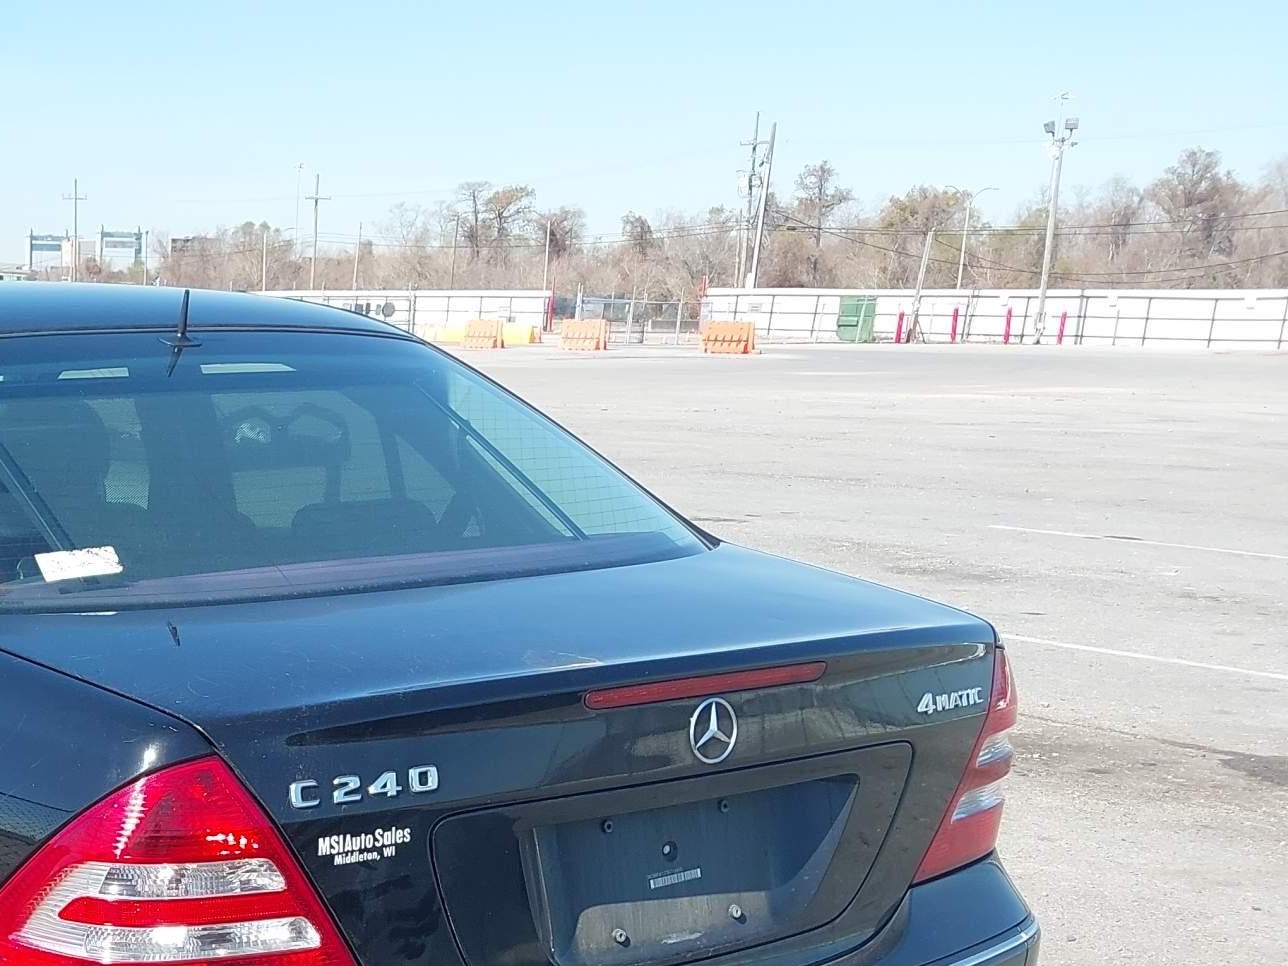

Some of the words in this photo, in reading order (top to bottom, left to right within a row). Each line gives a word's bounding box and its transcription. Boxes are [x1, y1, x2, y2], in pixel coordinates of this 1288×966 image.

[917, 687, 984, 715] 4MATIC
[289, 779, 320, 808] C
[333, 765, 439, 804] 240
[374, 826, 411, 847] Sales
[334, 851, 380, 865] Middleton,
[383, 846, 396, 857] WI
